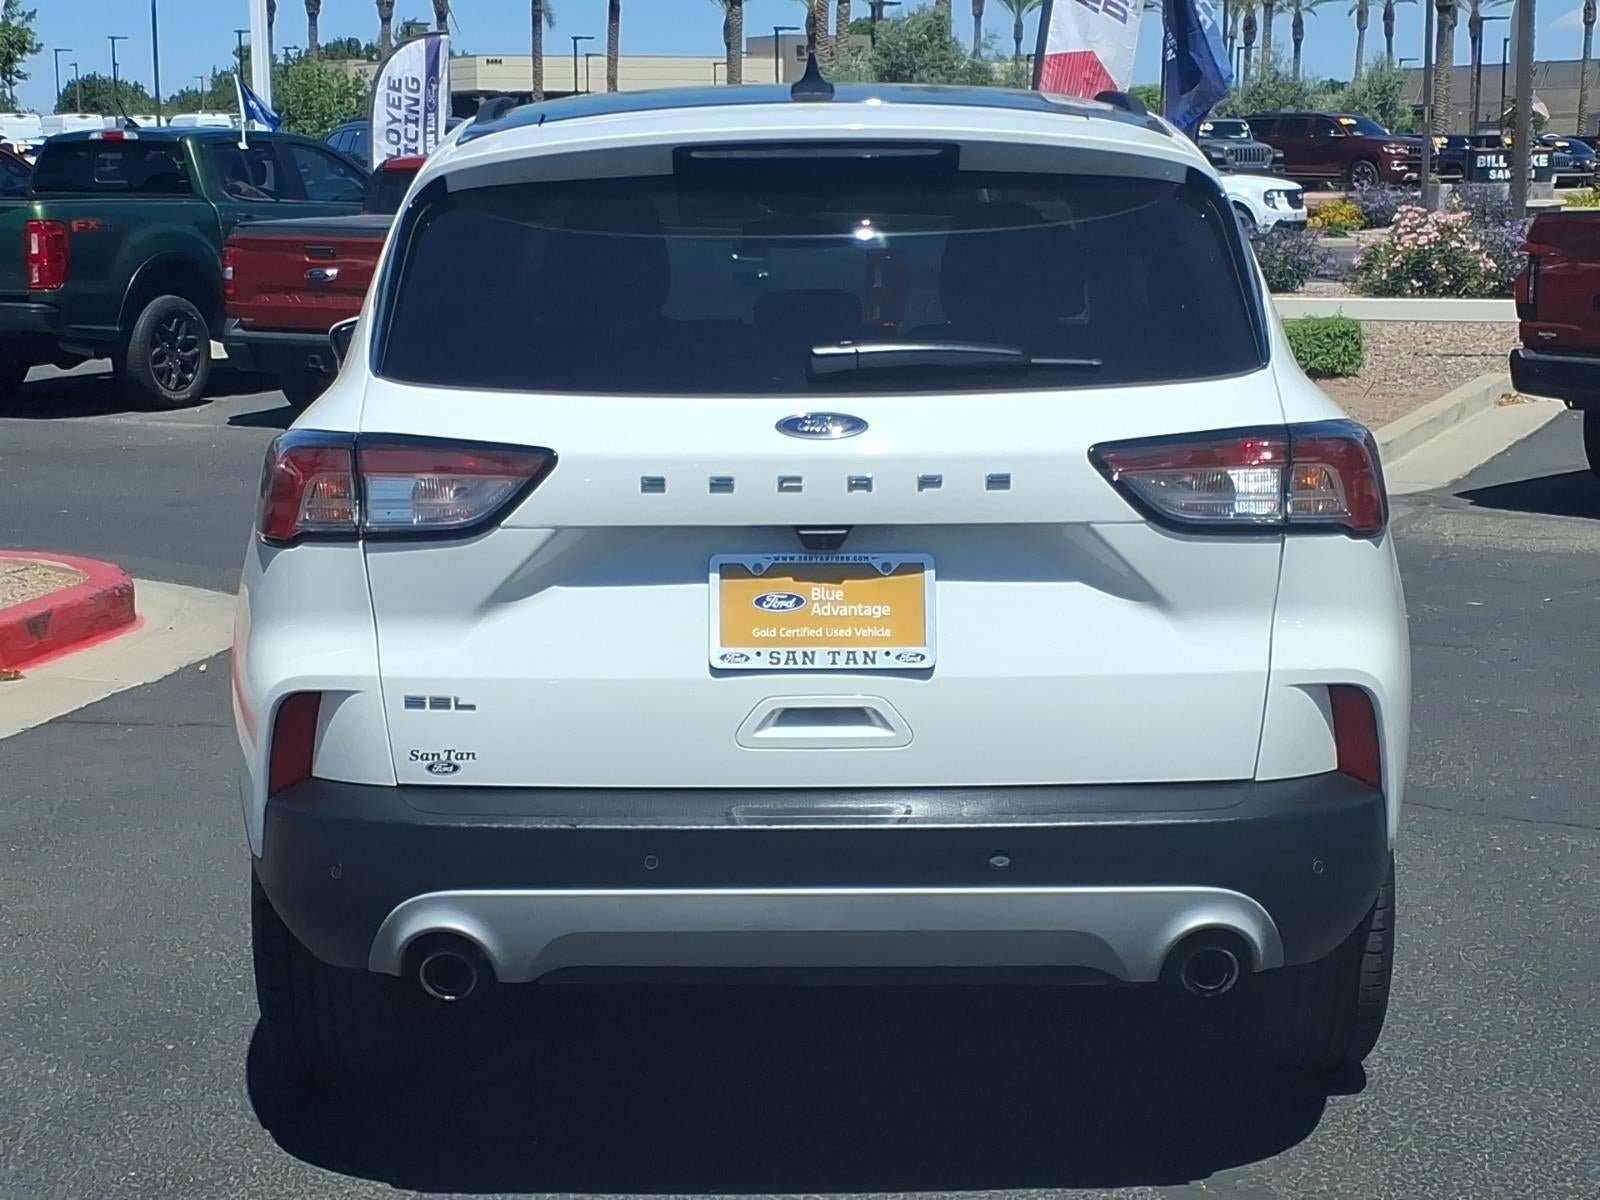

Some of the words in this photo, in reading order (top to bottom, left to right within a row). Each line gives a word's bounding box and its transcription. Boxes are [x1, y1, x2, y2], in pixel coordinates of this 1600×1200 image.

[1476, 155, 1508, 168] BILL
[811, 587, 844, 601] Blue
[760, 593, 798, 610] Ford
[811, 603, 891, 619] Advantage
[752, 627, 777, 638] Gold
[779, 626, 823, 638] Certified
[825, 627, 852, 638] Used
[854, 627, 891, 638] Vehicle
[769, 650, 816, 665] SAN
[827, 650, 877, 665] TAN
